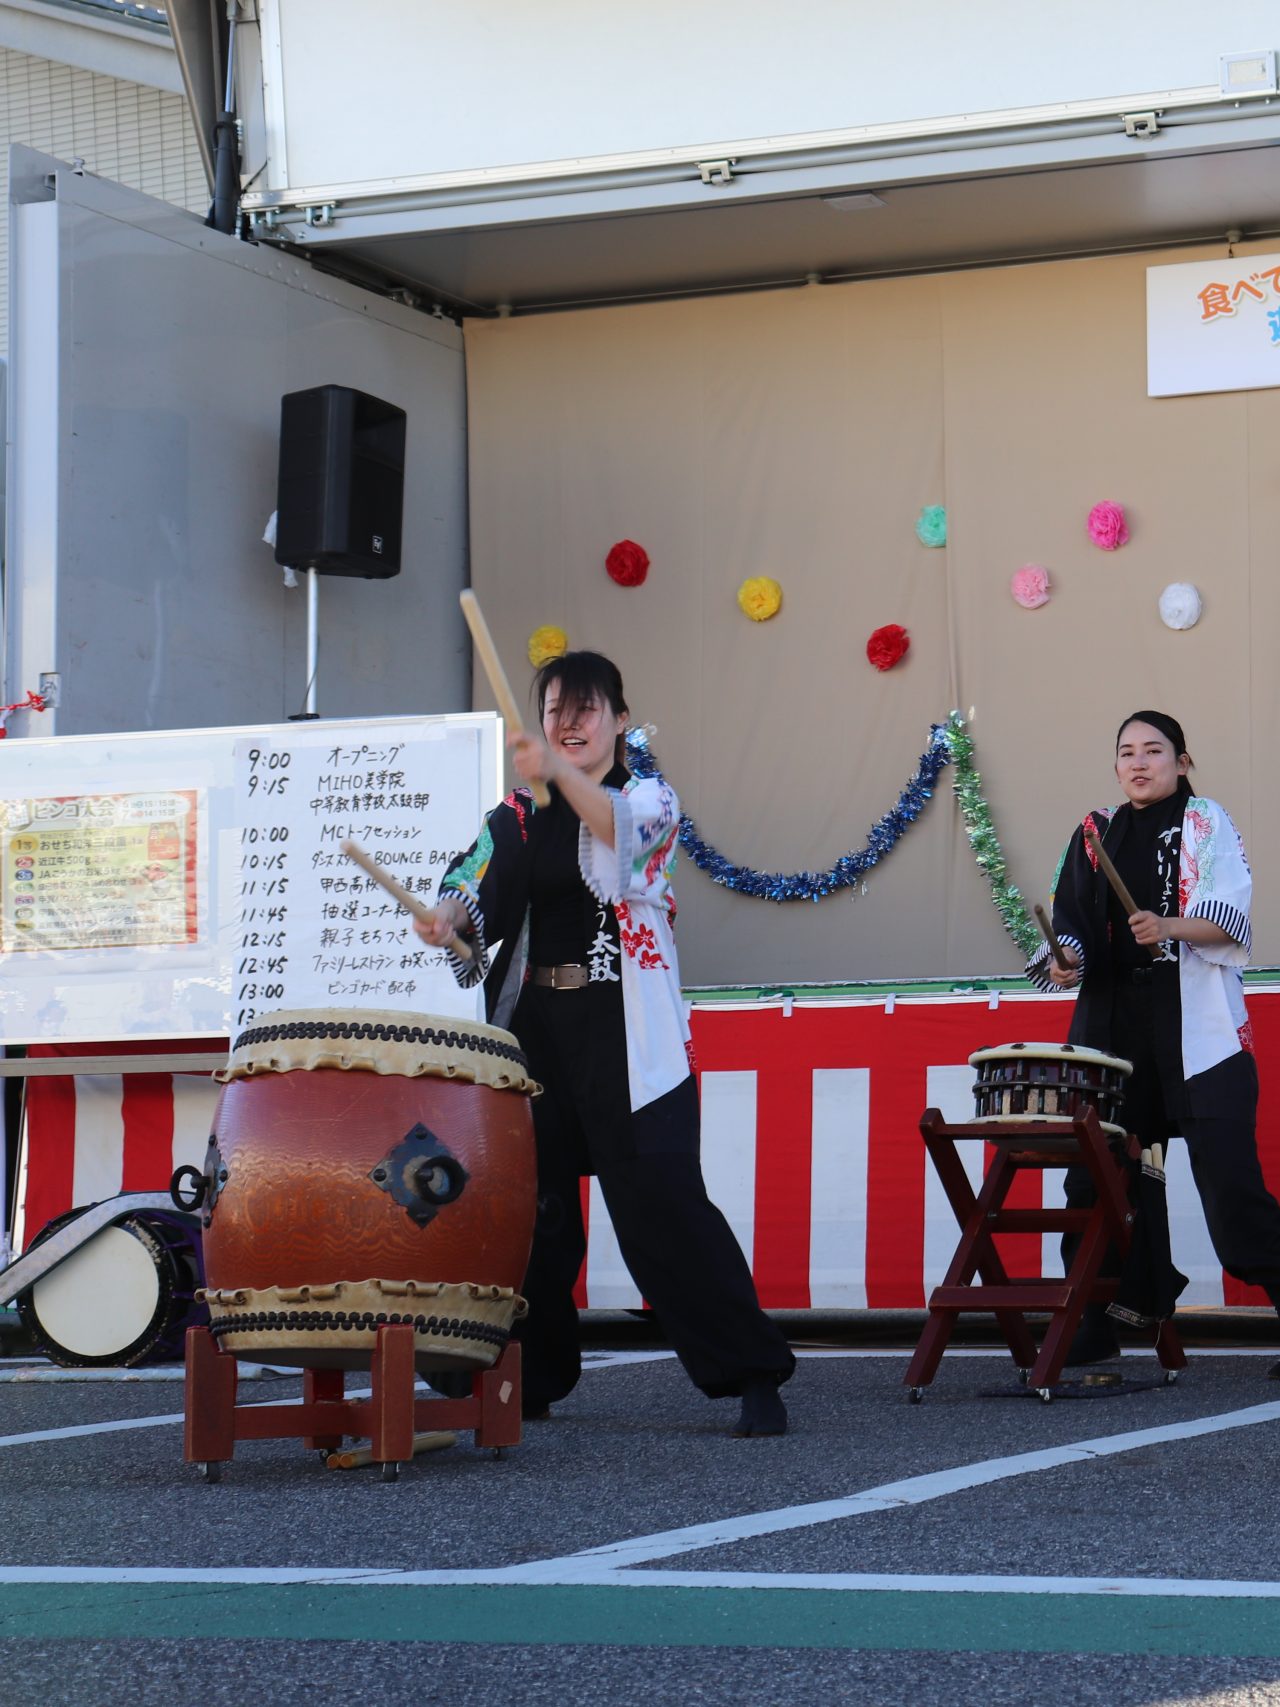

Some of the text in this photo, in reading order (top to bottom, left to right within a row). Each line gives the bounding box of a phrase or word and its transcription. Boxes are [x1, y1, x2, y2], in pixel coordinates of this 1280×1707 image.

[248, 743, 405, 772] 9:00 オープニング
[248, 770, 406, 797] 9:15 MIHO美学院
[241, 824, 422, 845] 10:00 MCトークセッション
[241, 850, 464, 870] 10:15 ダンススタ BOUNCE BAC
[241, 875, 432, 895] 11:15 甲西高校道部
[240, 907, 288, 924] 11:45
[242, 932, 286, 948] 12:15
[239, 955, 289, 974] 12:45
[312, 954, 396, 974] ファミリーレストラン
[239, 983, 284, 1000] 13:00
